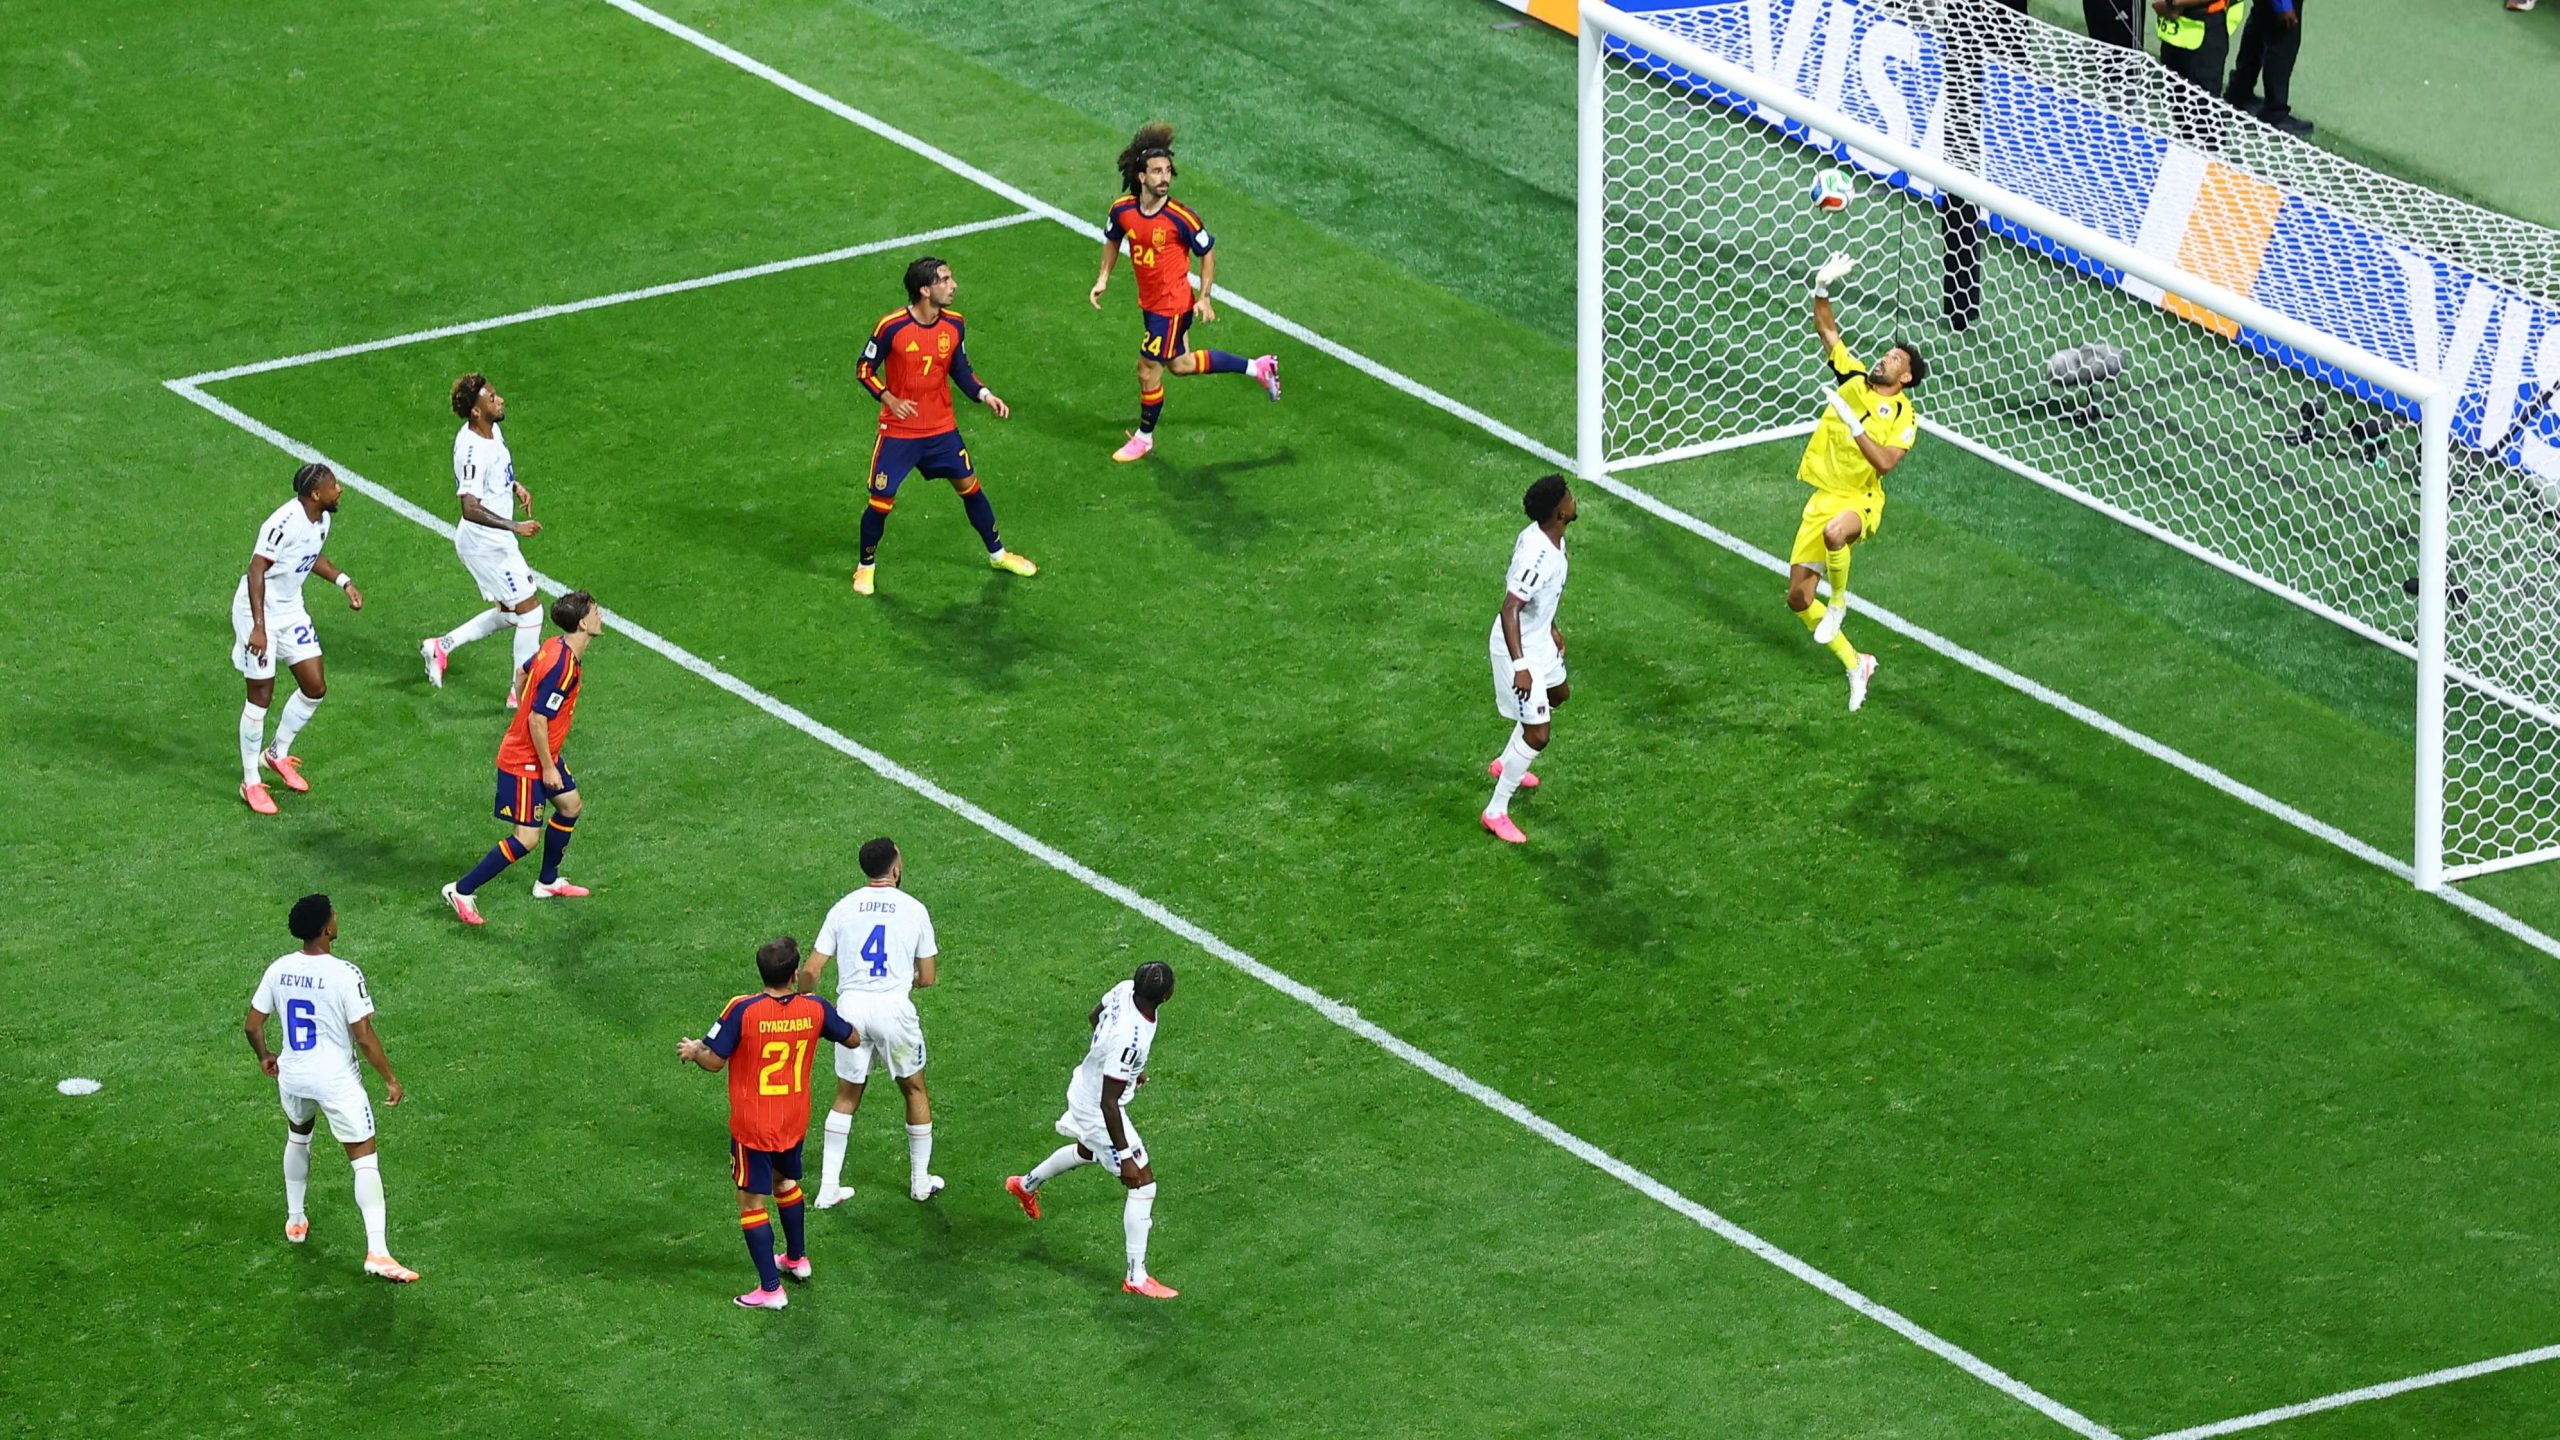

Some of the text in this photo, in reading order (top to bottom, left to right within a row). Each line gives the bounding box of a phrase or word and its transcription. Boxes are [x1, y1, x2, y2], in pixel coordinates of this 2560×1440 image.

[1133, 244, 1156, 268] 24
[1141, 331, 1162, 356] 24
[922, 355, 933, 376] 7
[959, 449, 971, 470] 7
[295, 553, 317, 573] 22
[859, 901, 896, 913] LOPES
[860, 925, 887, 977] 4
[318, 978, 325, 989] L
[287, 998, 317, 1051] 6
[759, 1016, 813, 1033] OYARZABAL
[759, 1039, 808, 1096] 21
